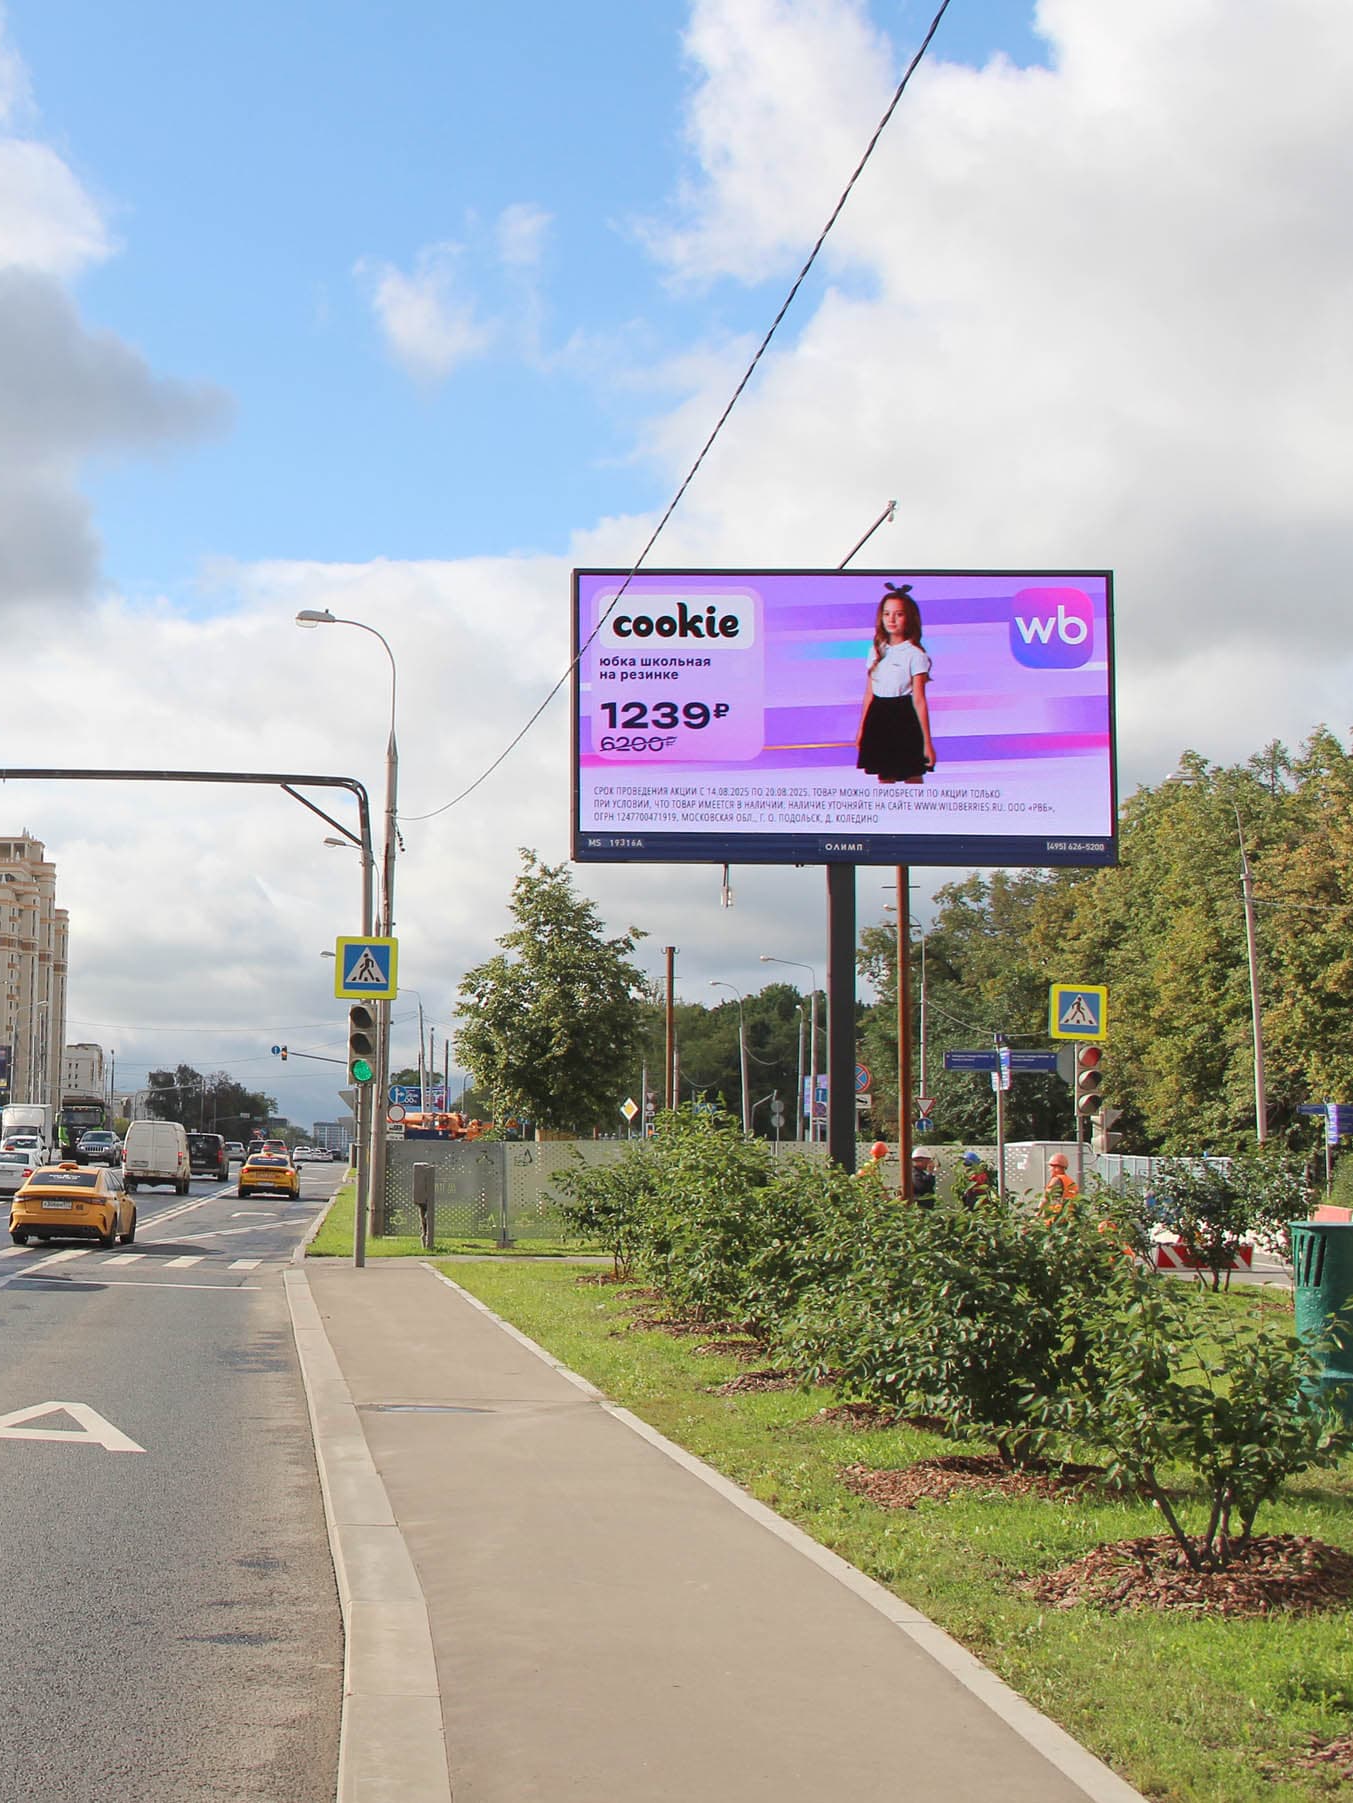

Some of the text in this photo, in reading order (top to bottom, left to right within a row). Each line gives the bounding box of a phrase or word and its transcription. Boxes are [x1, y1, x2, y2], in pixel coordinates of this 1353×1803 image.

[612, 602, 739, 638] cookie
[1015, 605, 1088, 645] wb
[599, 656, 711, 667] юбка школьная
[599, 671, 679, 682] на резинке
[593, 787, 614, 796] СРОК
[616, 787, 668, 797] ПРОВЕДЕНИЯ
[670, 787, 697, 798] АКЦИИ
[699, 787, 705, 797] С
[707, 787, 749, 797] 14.08.2025
[751, 788, 763, 797] ПО
[813, 788, 837, 797] ТОВАР
[839, 788, 870, 798] МОЖНО
[872, 788, 924, 798] ПРИОБРЕСТИ
[927, 789, 938, 798] ПО
[941, 789, 968, 799] АКЦИИ
[970, 789, 1000, 799] ТОЛЬКО
[593, 800, 610, 809] ПРИ
[655, 800, 670, 809] ЧТО
[672, 800, 697, 809] ТОВАР
[698, 800, 735, 809] ИМЕЕТСЯ
[737, 800, 742, 809] В
[788, 801, 826, 810] НАЛИЧИЕ
[828, 800, 872, 810] УТОЧНЯЙТЕ
[875, 801, 885, 811] НА
[888, 801, 911, 811] САЙТЕ
[1008, 803, 1026, 812] ООО
[593, 813, 614, 821] ОГРН
[681, 813, 734, 822] МОСКОВСКАЯ
[836, 814, 879, 824] КОЛЕДИНО
[825, 843, 863, 851] ОЛИМП
